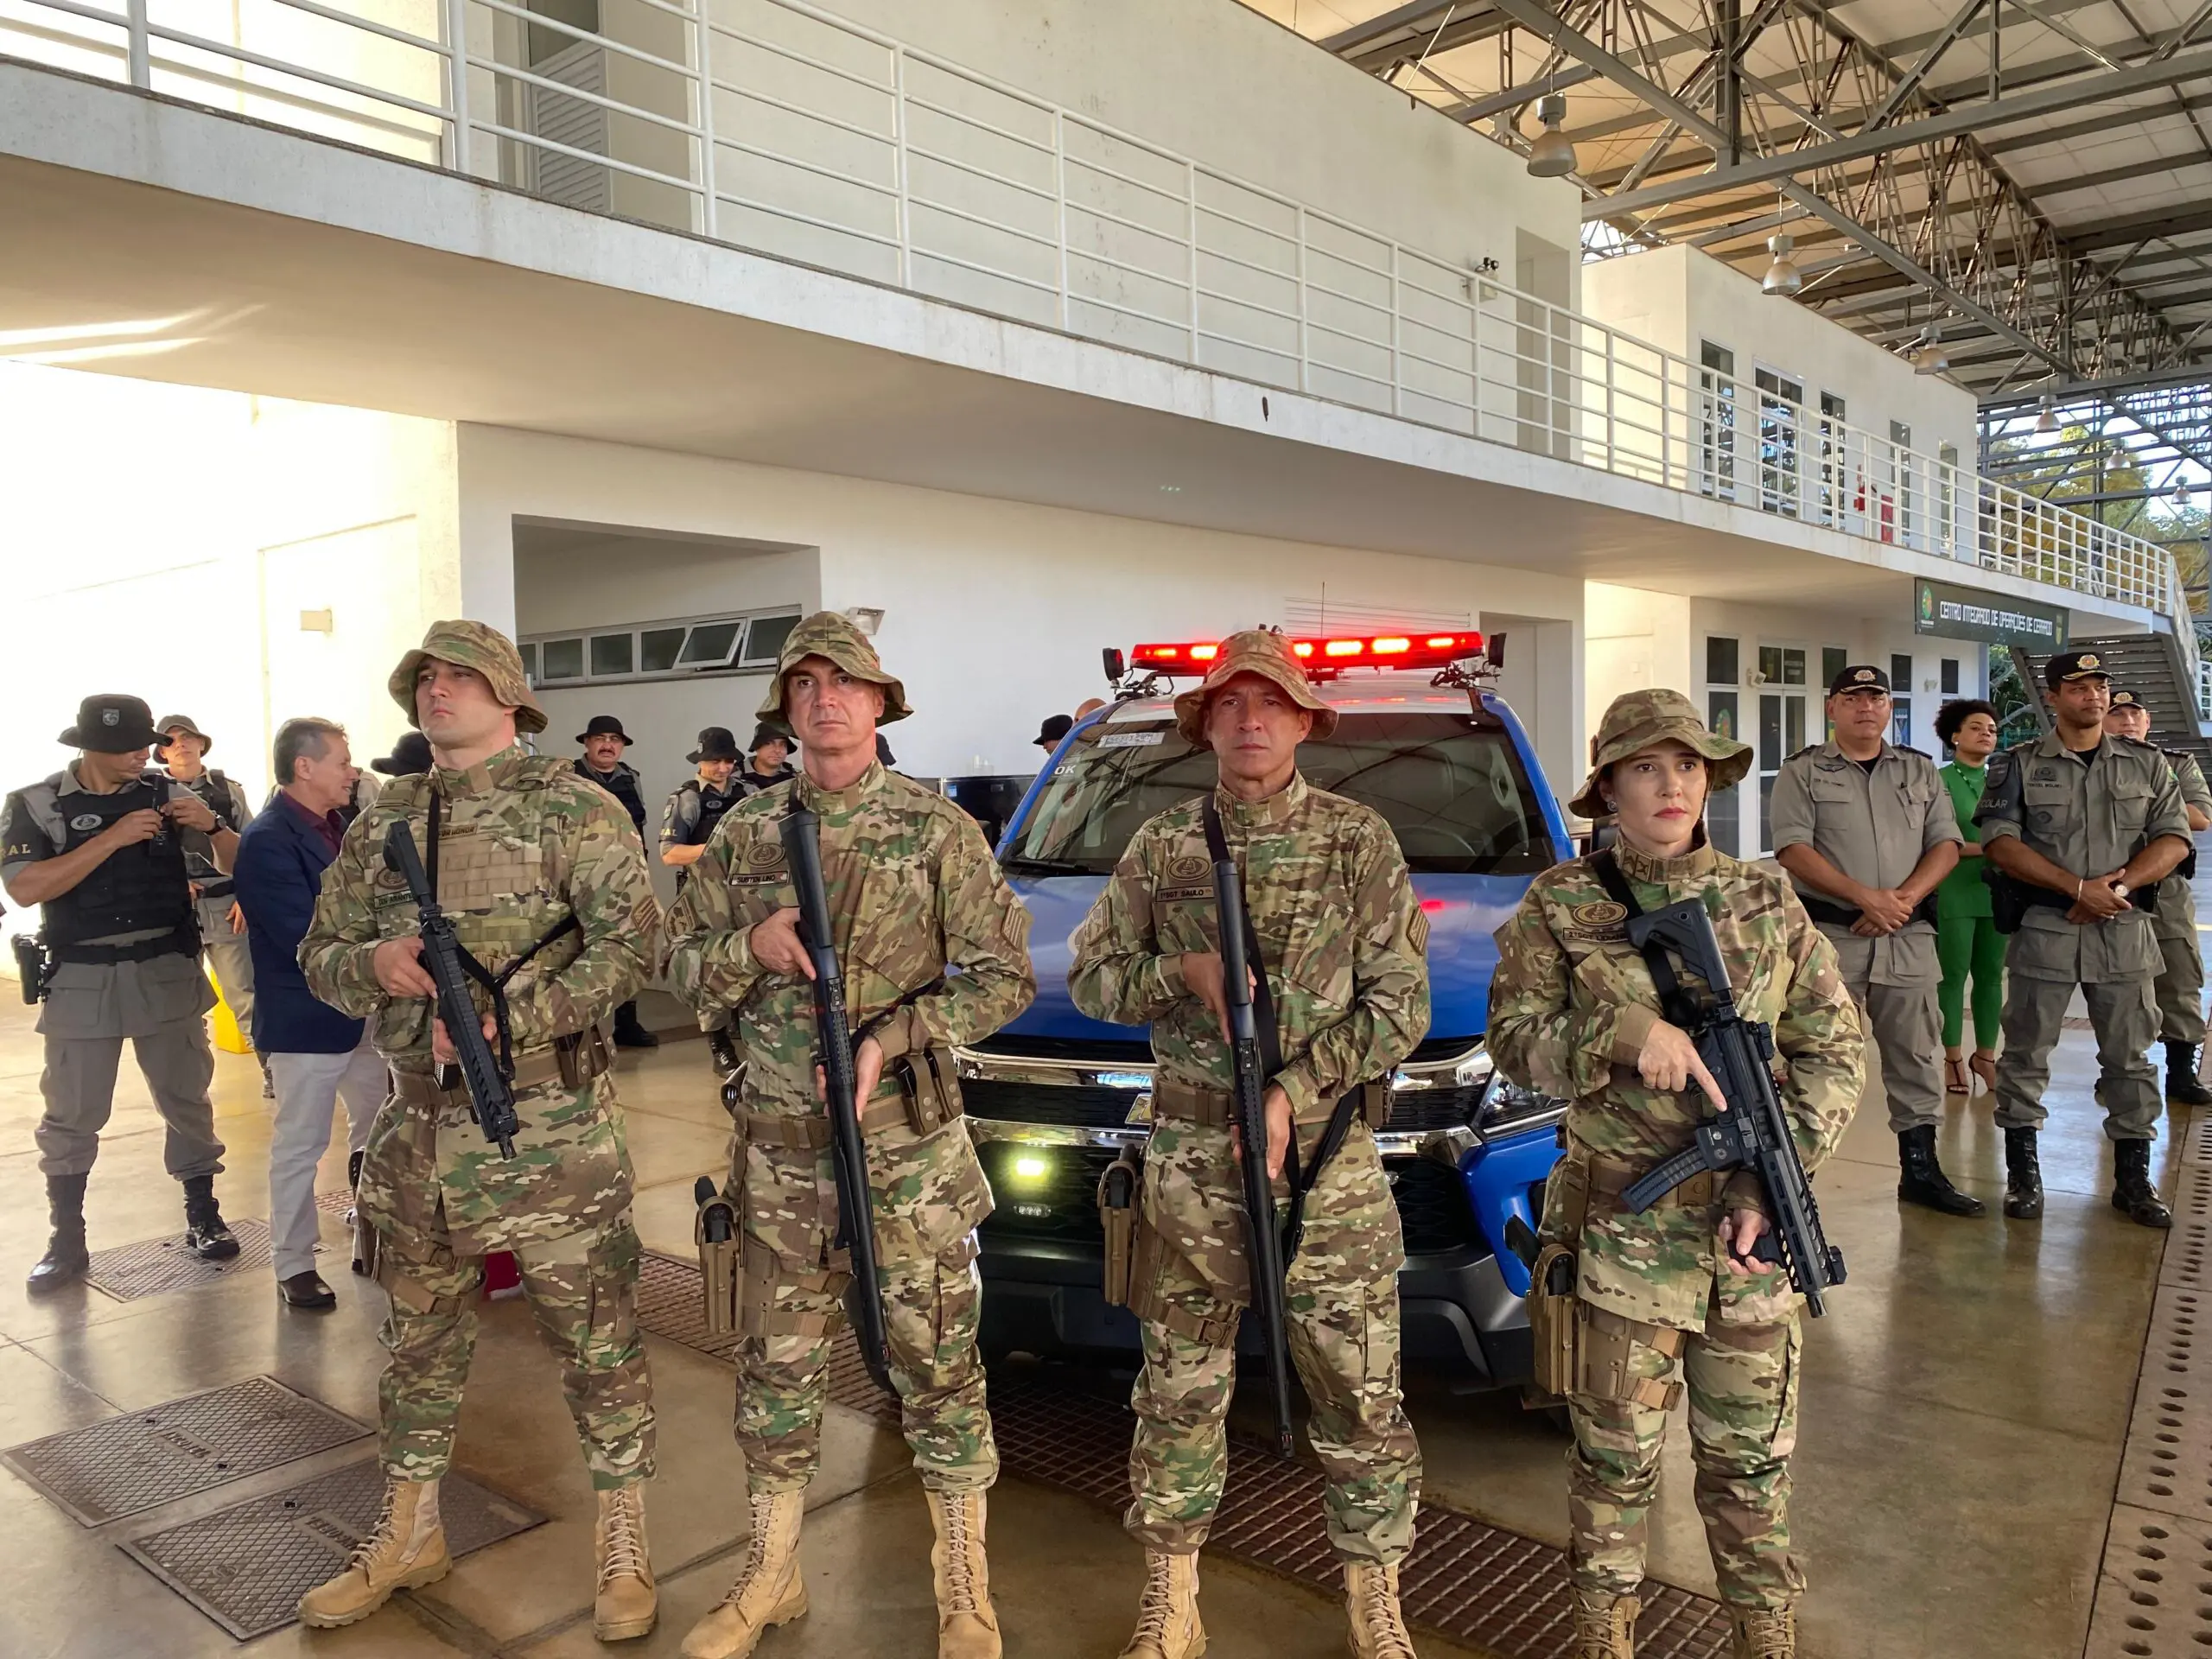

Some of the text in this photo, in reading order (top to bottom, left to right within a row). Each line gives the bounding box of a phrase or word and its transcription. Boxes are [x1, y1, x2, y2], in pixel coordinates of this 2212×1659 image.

[1940, 601, 1962, 621] CENTRO
[1962, 605, 1990, 626] INTEGRADO
[1991, 610, 1999, 626] DE
[1999, 611, 2026, 633] OPERAÇÕES
[2026, 617, 2033, 632] DE
[1054, 765, 1077, 775] OK
[1180, 888, 1204, 897] SAULO
